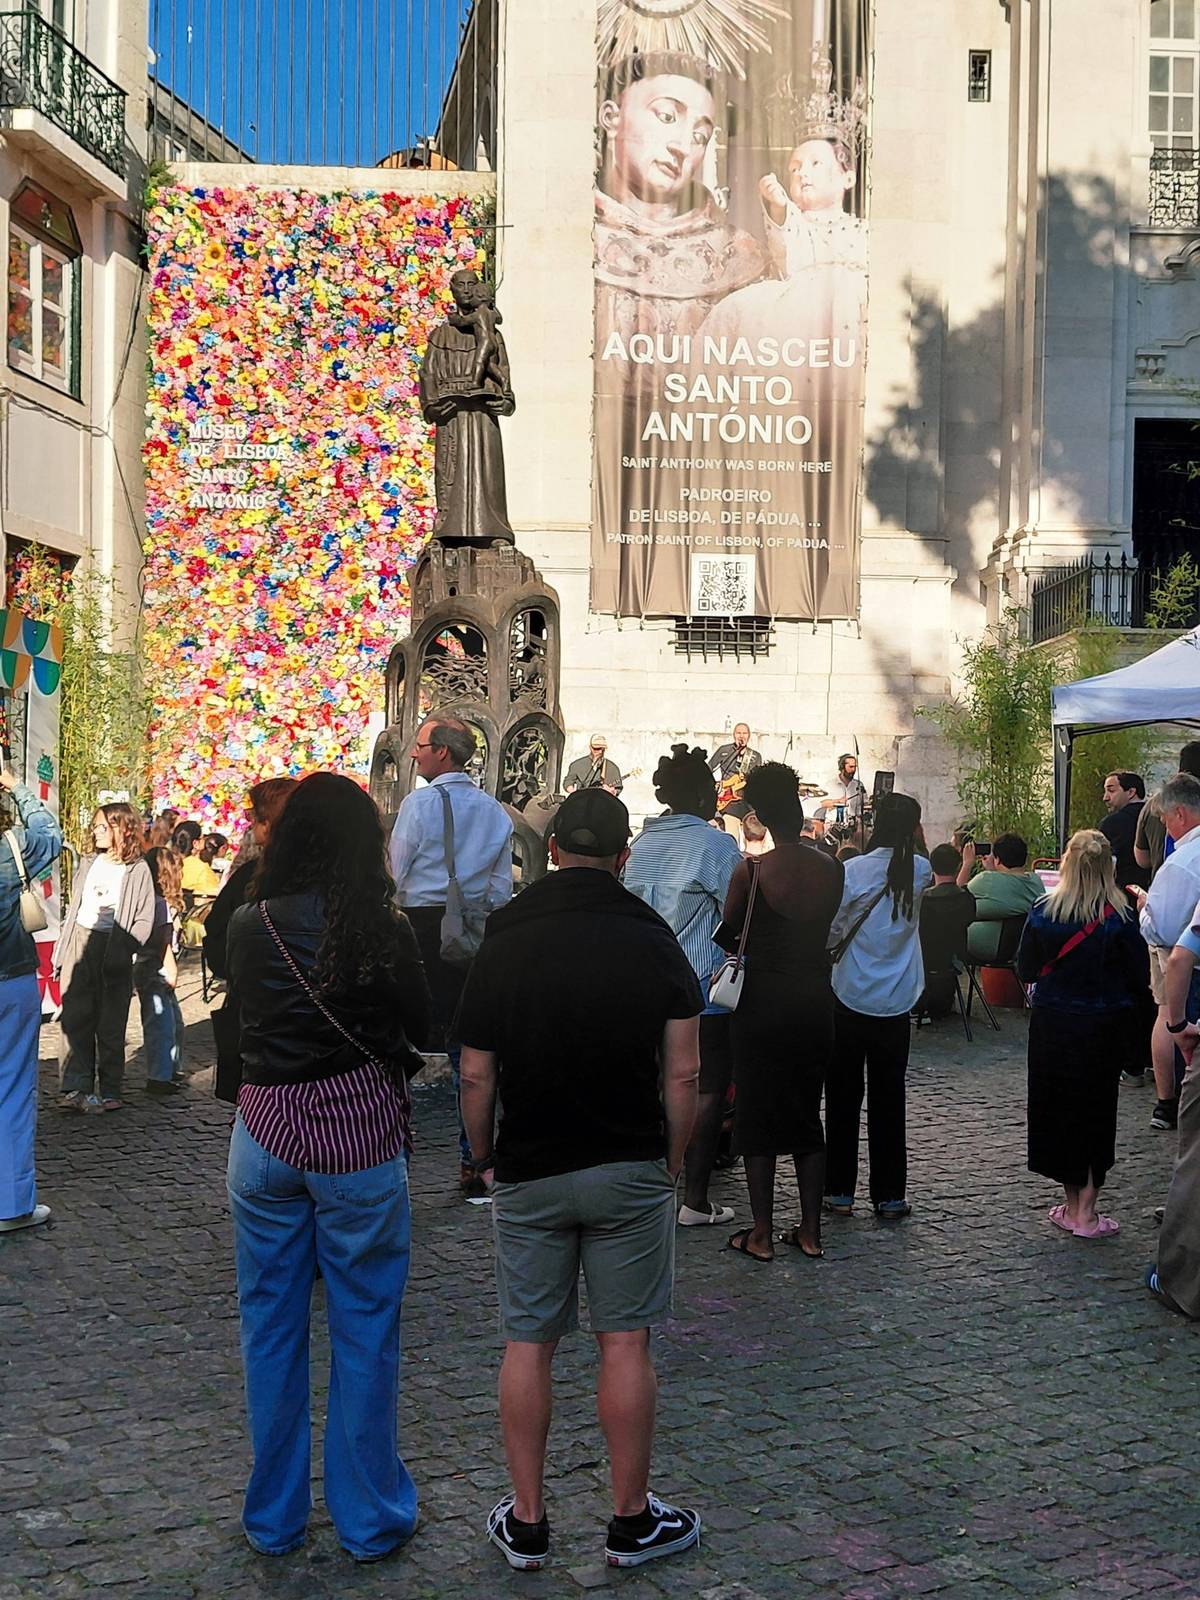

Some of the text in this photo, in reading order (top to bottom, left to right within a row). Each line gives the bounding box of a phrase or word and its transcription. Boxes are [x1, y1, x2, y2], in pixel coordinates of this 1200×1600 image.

[601, 331, 857, 368] AQUI NASCEU
[663, 373, 793, 406] SANTO
[189, 424, 247, 440] MUSEU
[641, 407, 813, 446] ANTÓNIO
[189, 442, 288, 460] DE LISBOA
[622, 456, 832, 473] SAINT ANTHONY WAS BORN HERE
[189, 468, 248, 484] SANTO
[680, 488, 772, 503] PADROEIRO
[629, 509, 651, 523] DE
[654, 510, 717, 526] LISBOA,
[720, 511, 742, 524] DE
[746, 509, 804, 528] PÁDUA,
[607, 532, 653, 545] PATRON
[655, 534, 693, 546] SAINT
[694, 535, 712, 546] OF
[715, 535, 764, 549] LISBON,
[767, 537, 784, 548] OF
[787, 538, 831, 550] PADUA,
